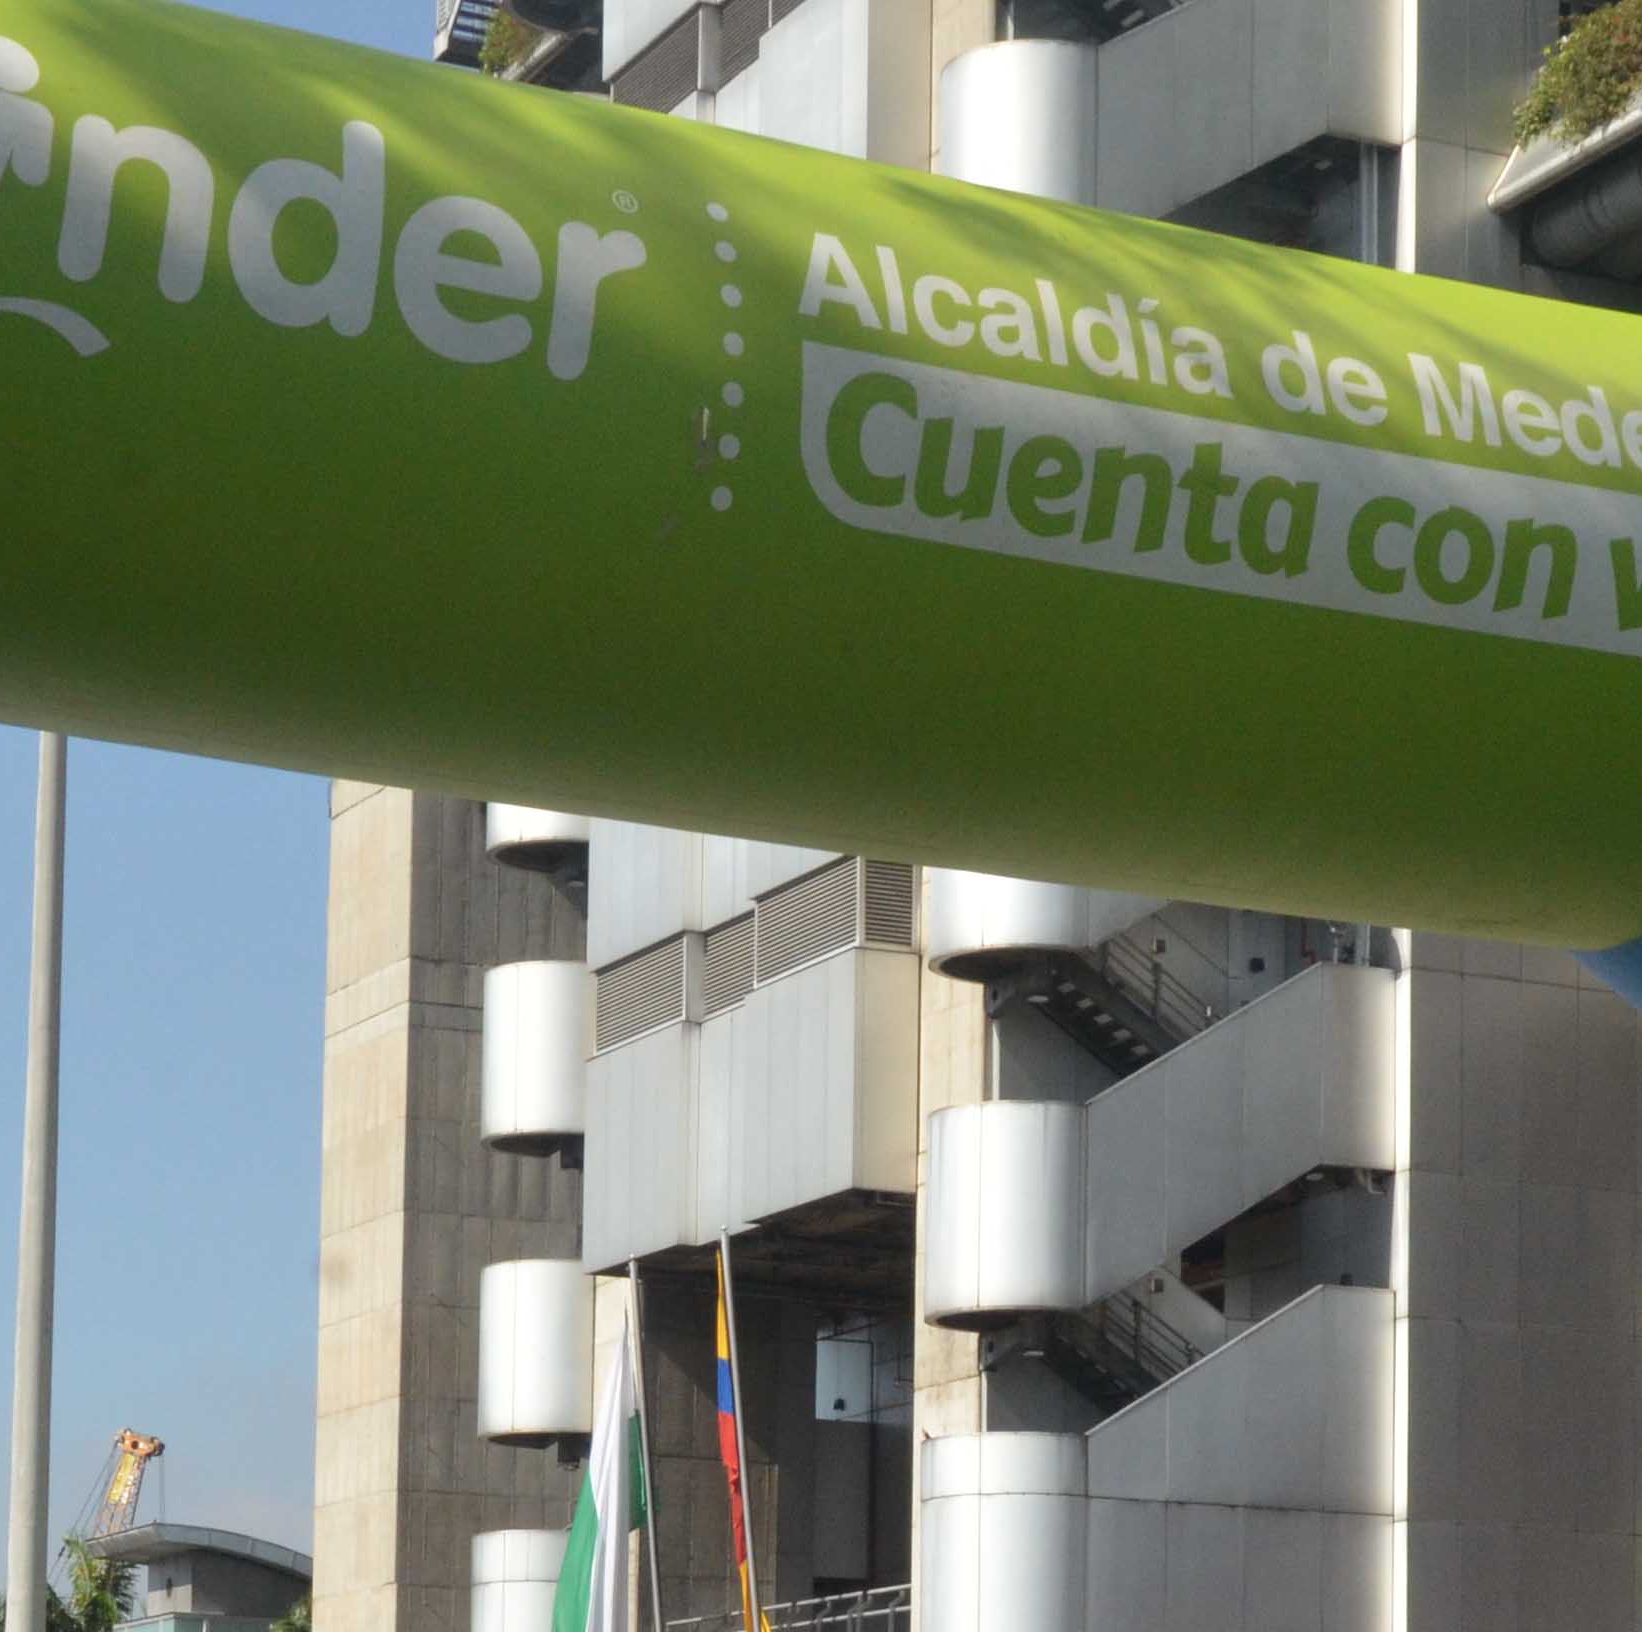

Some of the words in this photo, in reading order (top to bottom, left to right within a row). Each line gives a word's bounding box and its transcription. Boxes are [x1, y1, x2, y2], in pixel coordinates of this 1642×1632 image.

[799, 232, 1233, 398] Alcaldía
[1261, 328, 1389, 427] de
[822, 370, 1323, 579] Cuenta
[1347, 490, 1580, 621] con
